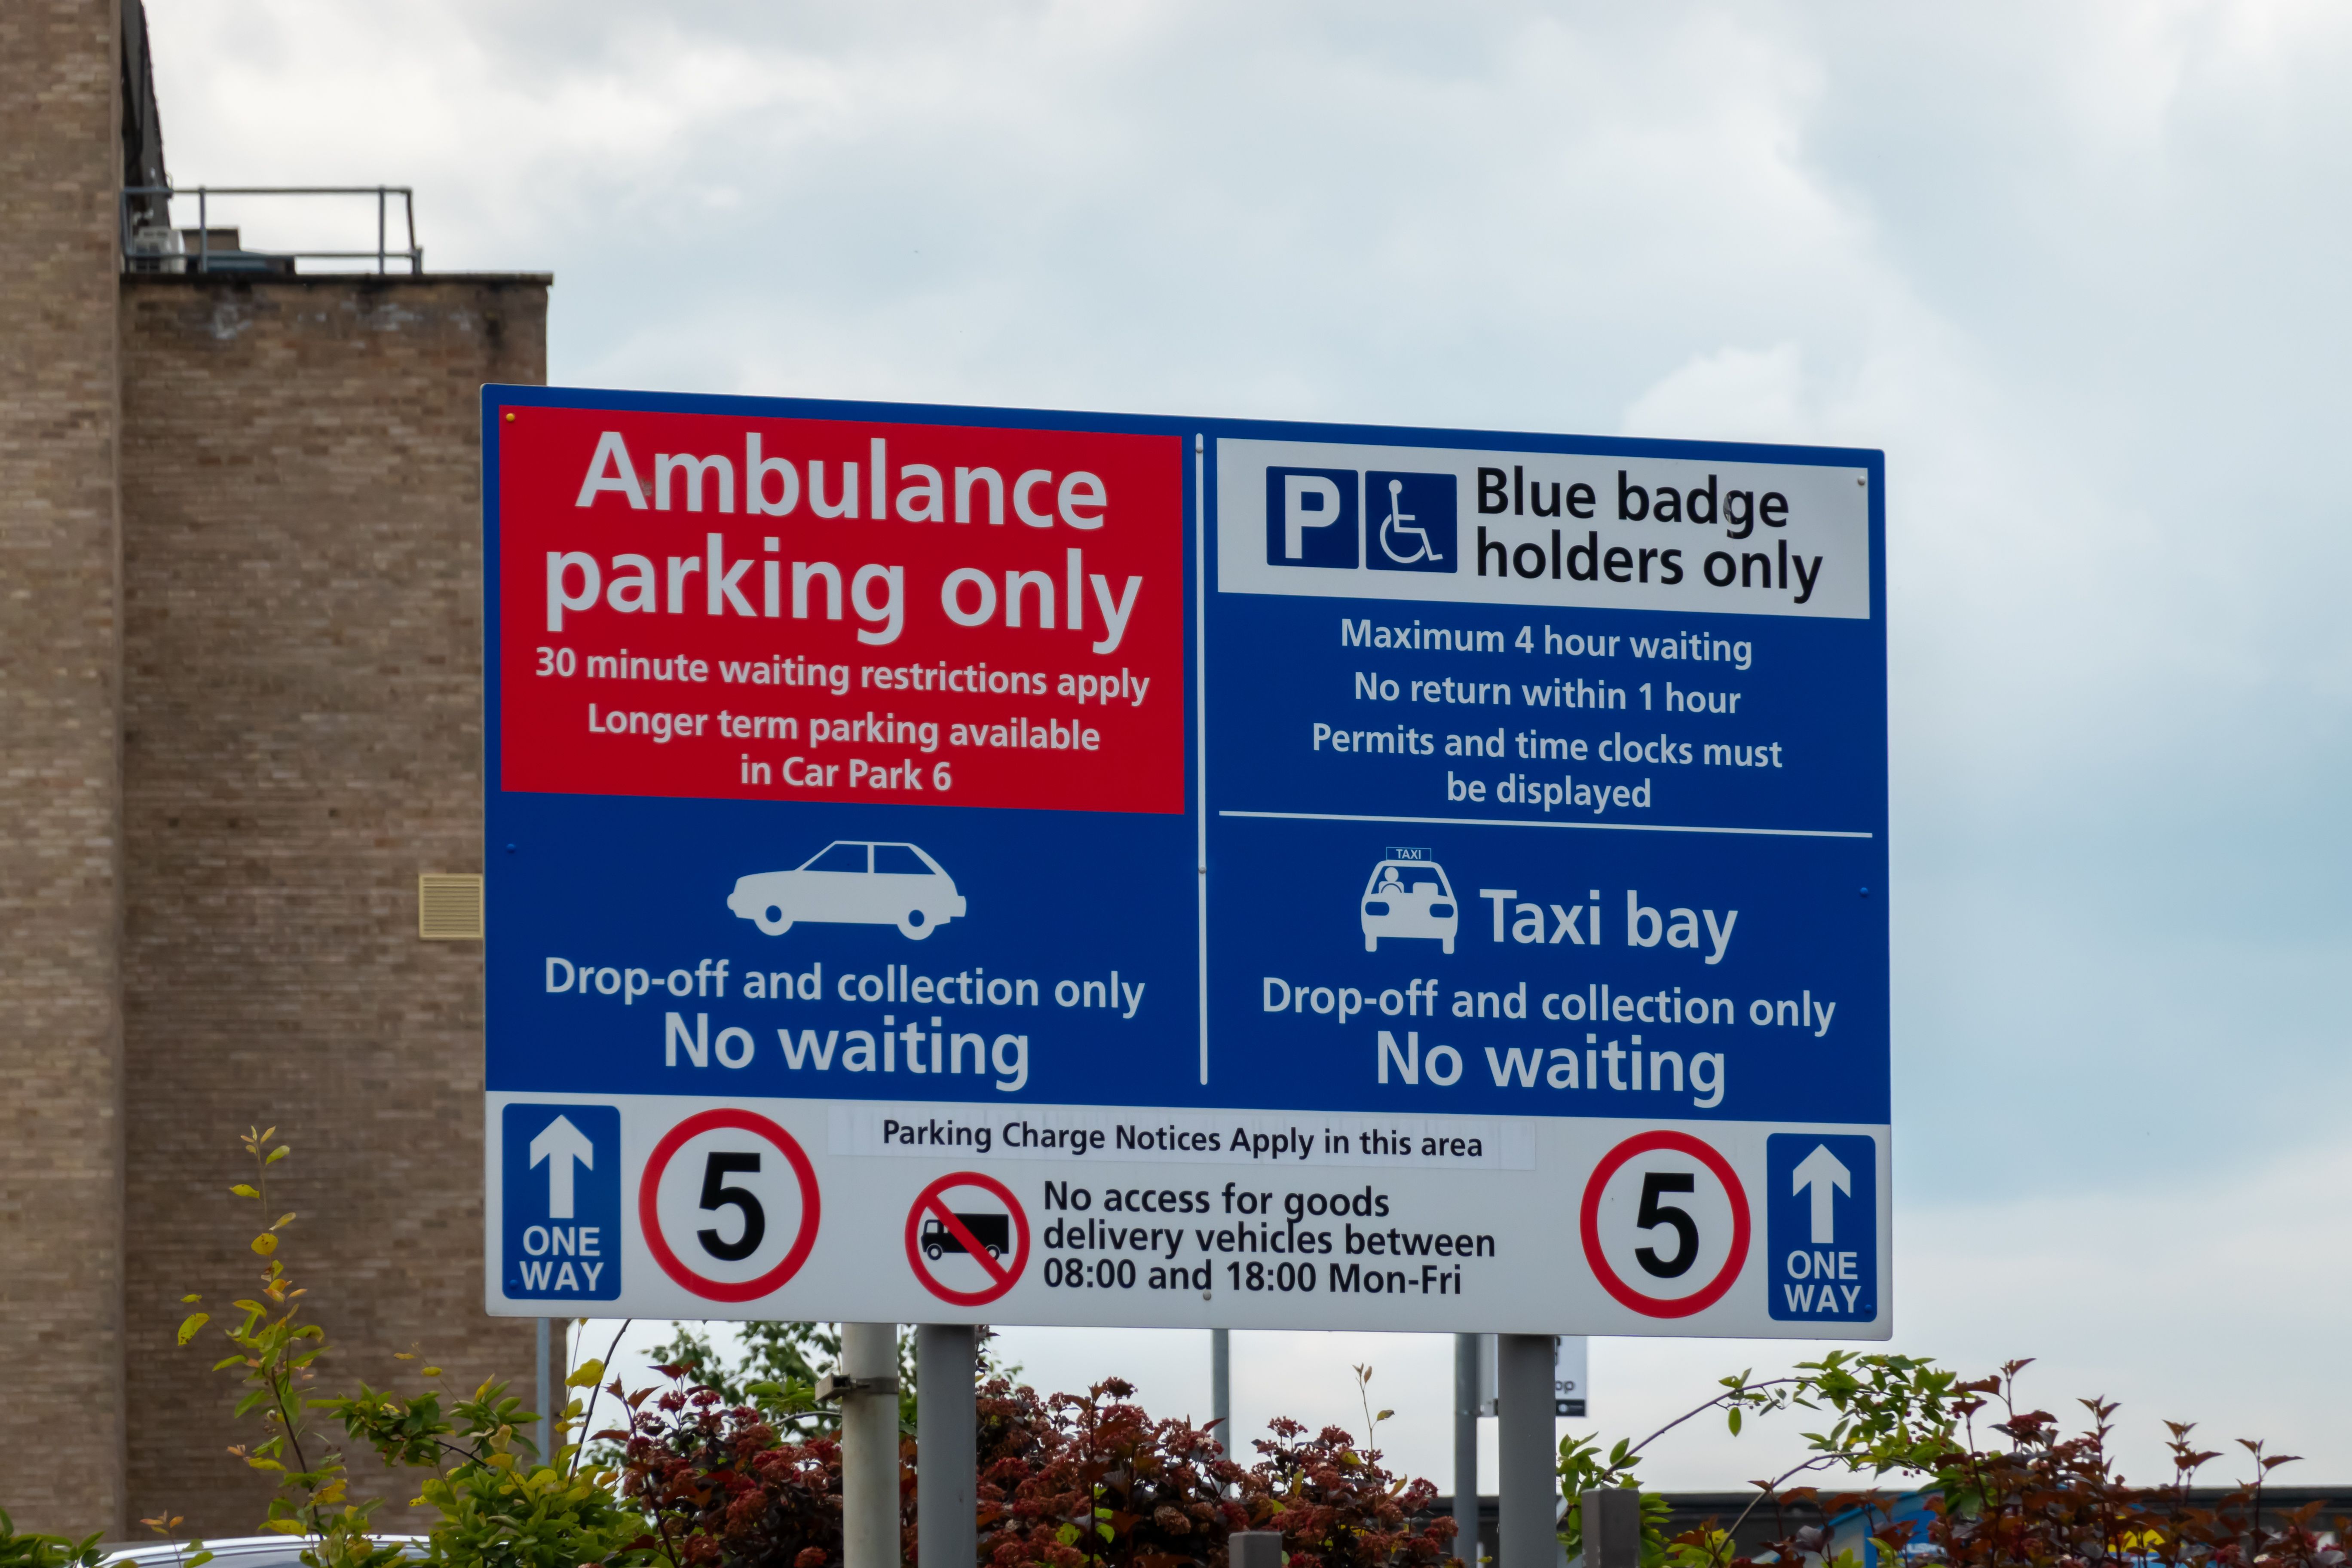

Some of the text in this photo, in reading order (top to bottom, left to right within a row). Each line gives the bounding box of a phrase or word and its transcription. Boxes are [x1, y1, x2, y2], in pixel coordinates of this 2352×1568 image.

[576, 431, 1106, 529] Ambulance
[1478, 465, 1788, 539] Blue badge
[1285, 475, 1340, 559] P
[1478, 526, 1823, 604] holders only
[547, 533, 1142, 654] parking only
[1342, 619, 1752, 670] Maximum 4 hour waiting
[536, 647, 1149, 706] 30 minute waiting restrictions apply
[1356, 672, 1741, 714] No return within 1 hour
[589, 703, 1099, 752] Longer term parking available
[1314, 723, 1782, 768] Permits and time clocks must
[742, 754, 952, 791] in Car Park 6
[1448, 771, 1651, 810] be displayed
[1396, 849, 1421, 859] TAXI
[1480, 889, 1738, 965] Taxi bay
[546, 957, 1145, 1019] Drop-off and collection only
[1264, 977, 1836, 1037] Drop-off and collection only
[666, 1012, 1028, 1092] No waiting
[1378, 1031, 1724, 1108] No waiting
[884, 1119, 1482, 1160] Parking Charge Notices Apply in this area
[697, 1152, 765, 1262] 5
[1045, 1181, 1389, 1222] No access for goods
[1635, 1172, 1699, 1279] 5
[524, 1226, 600, 1256] ONE
[1044, 1218, 1495, 1260] delivery vehicles between
[520, 1261, 604, 1291] WAY
[1044, 1258, 1460, 1294] 08:00 and 18:00 Mon-Fri
[1787, 1250, 1858, 1280] ONE
[1784, 1284, 1862, 1313] WAY
